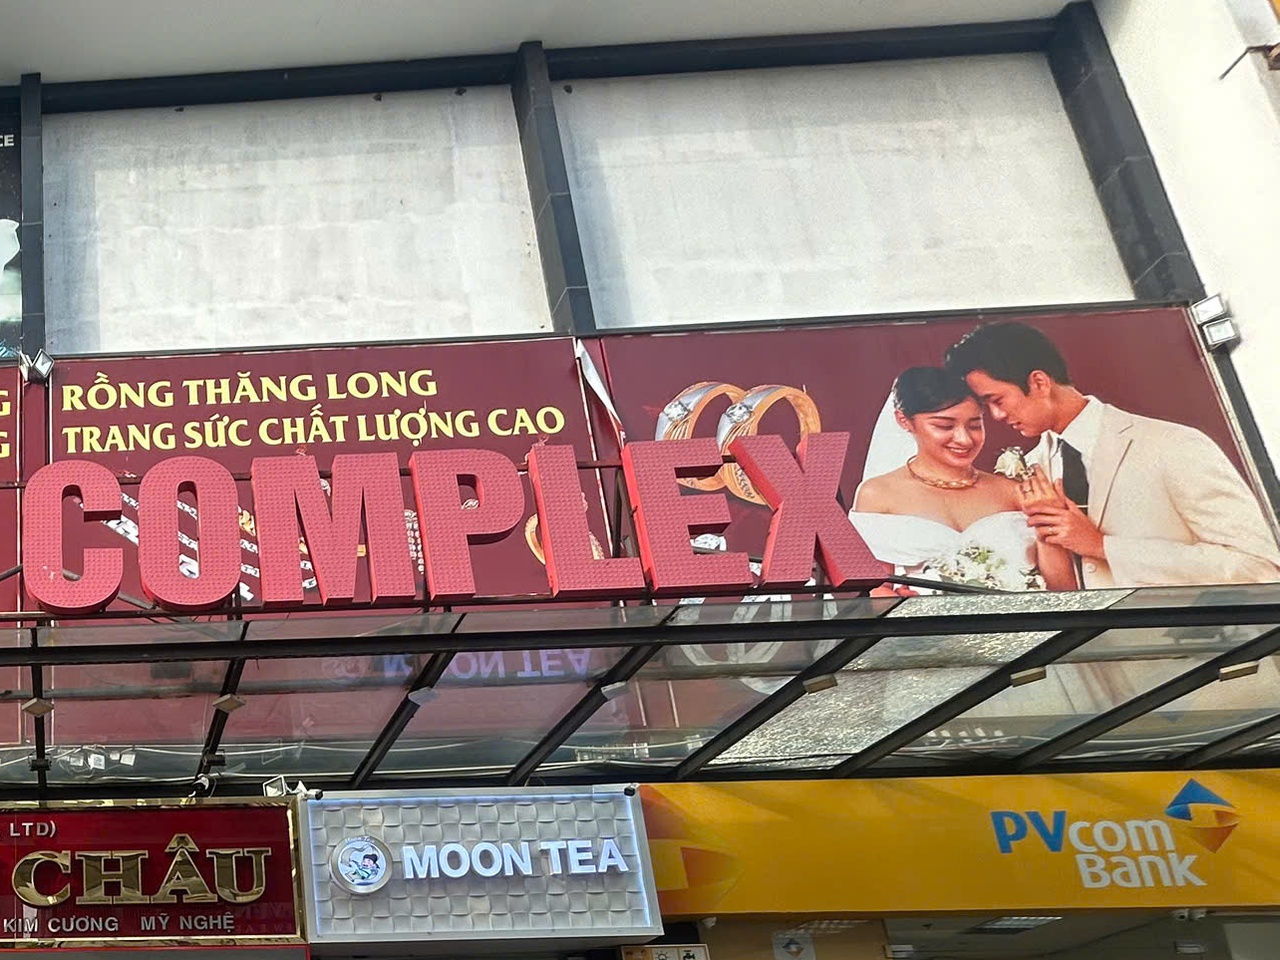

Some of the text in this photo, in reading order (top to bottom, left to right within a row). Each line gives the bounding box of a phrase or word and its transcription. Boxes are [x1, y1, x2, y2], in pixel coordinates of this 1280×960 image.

[61, 369, 438, 411] RỒNG THĂNG LONG
[61, 403, 566, 454] TRANG SỨC CHẤT LƯỢNG CAO
[22, 431, 892, 614] COMPLEX
[9, 819, 57, 839] LTD)
[990, 809, 1176, 855] PVcom
[10, 833, 273, 908] CHÂU
[402, 838, 629, 880] MOON TEA
[1075, 852, 1208, 889] Bank
[3, 917, 39, 934] KIM
[47, 914, 120, 933] CƯƠNG
[140, 911, 173, 931] MỸ
[179, 911, 236, 934] NGHỆ
